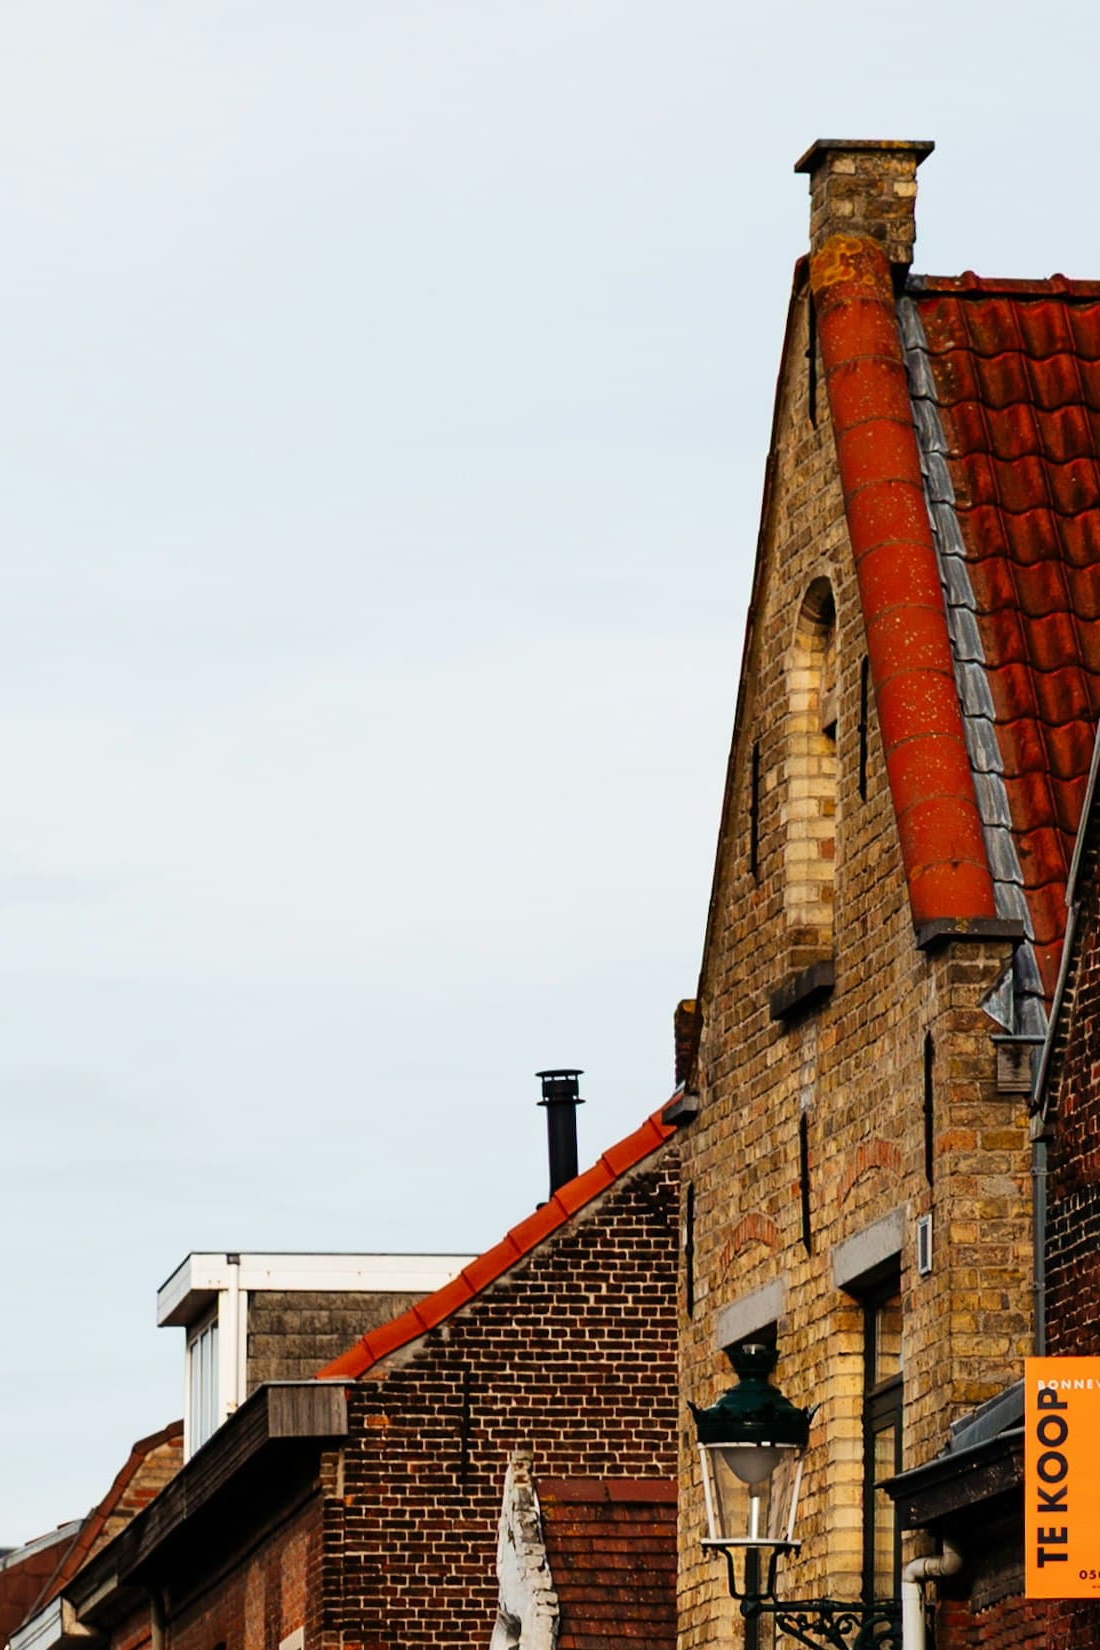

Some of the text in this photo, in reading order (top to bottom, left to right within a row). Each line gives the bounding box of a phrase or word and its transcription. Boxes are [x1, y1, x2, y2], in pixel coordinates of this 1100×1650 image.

[1037, 1387, 1068, 1568] TE KOOP
[1079, 1569, 1100, 1580] 05
